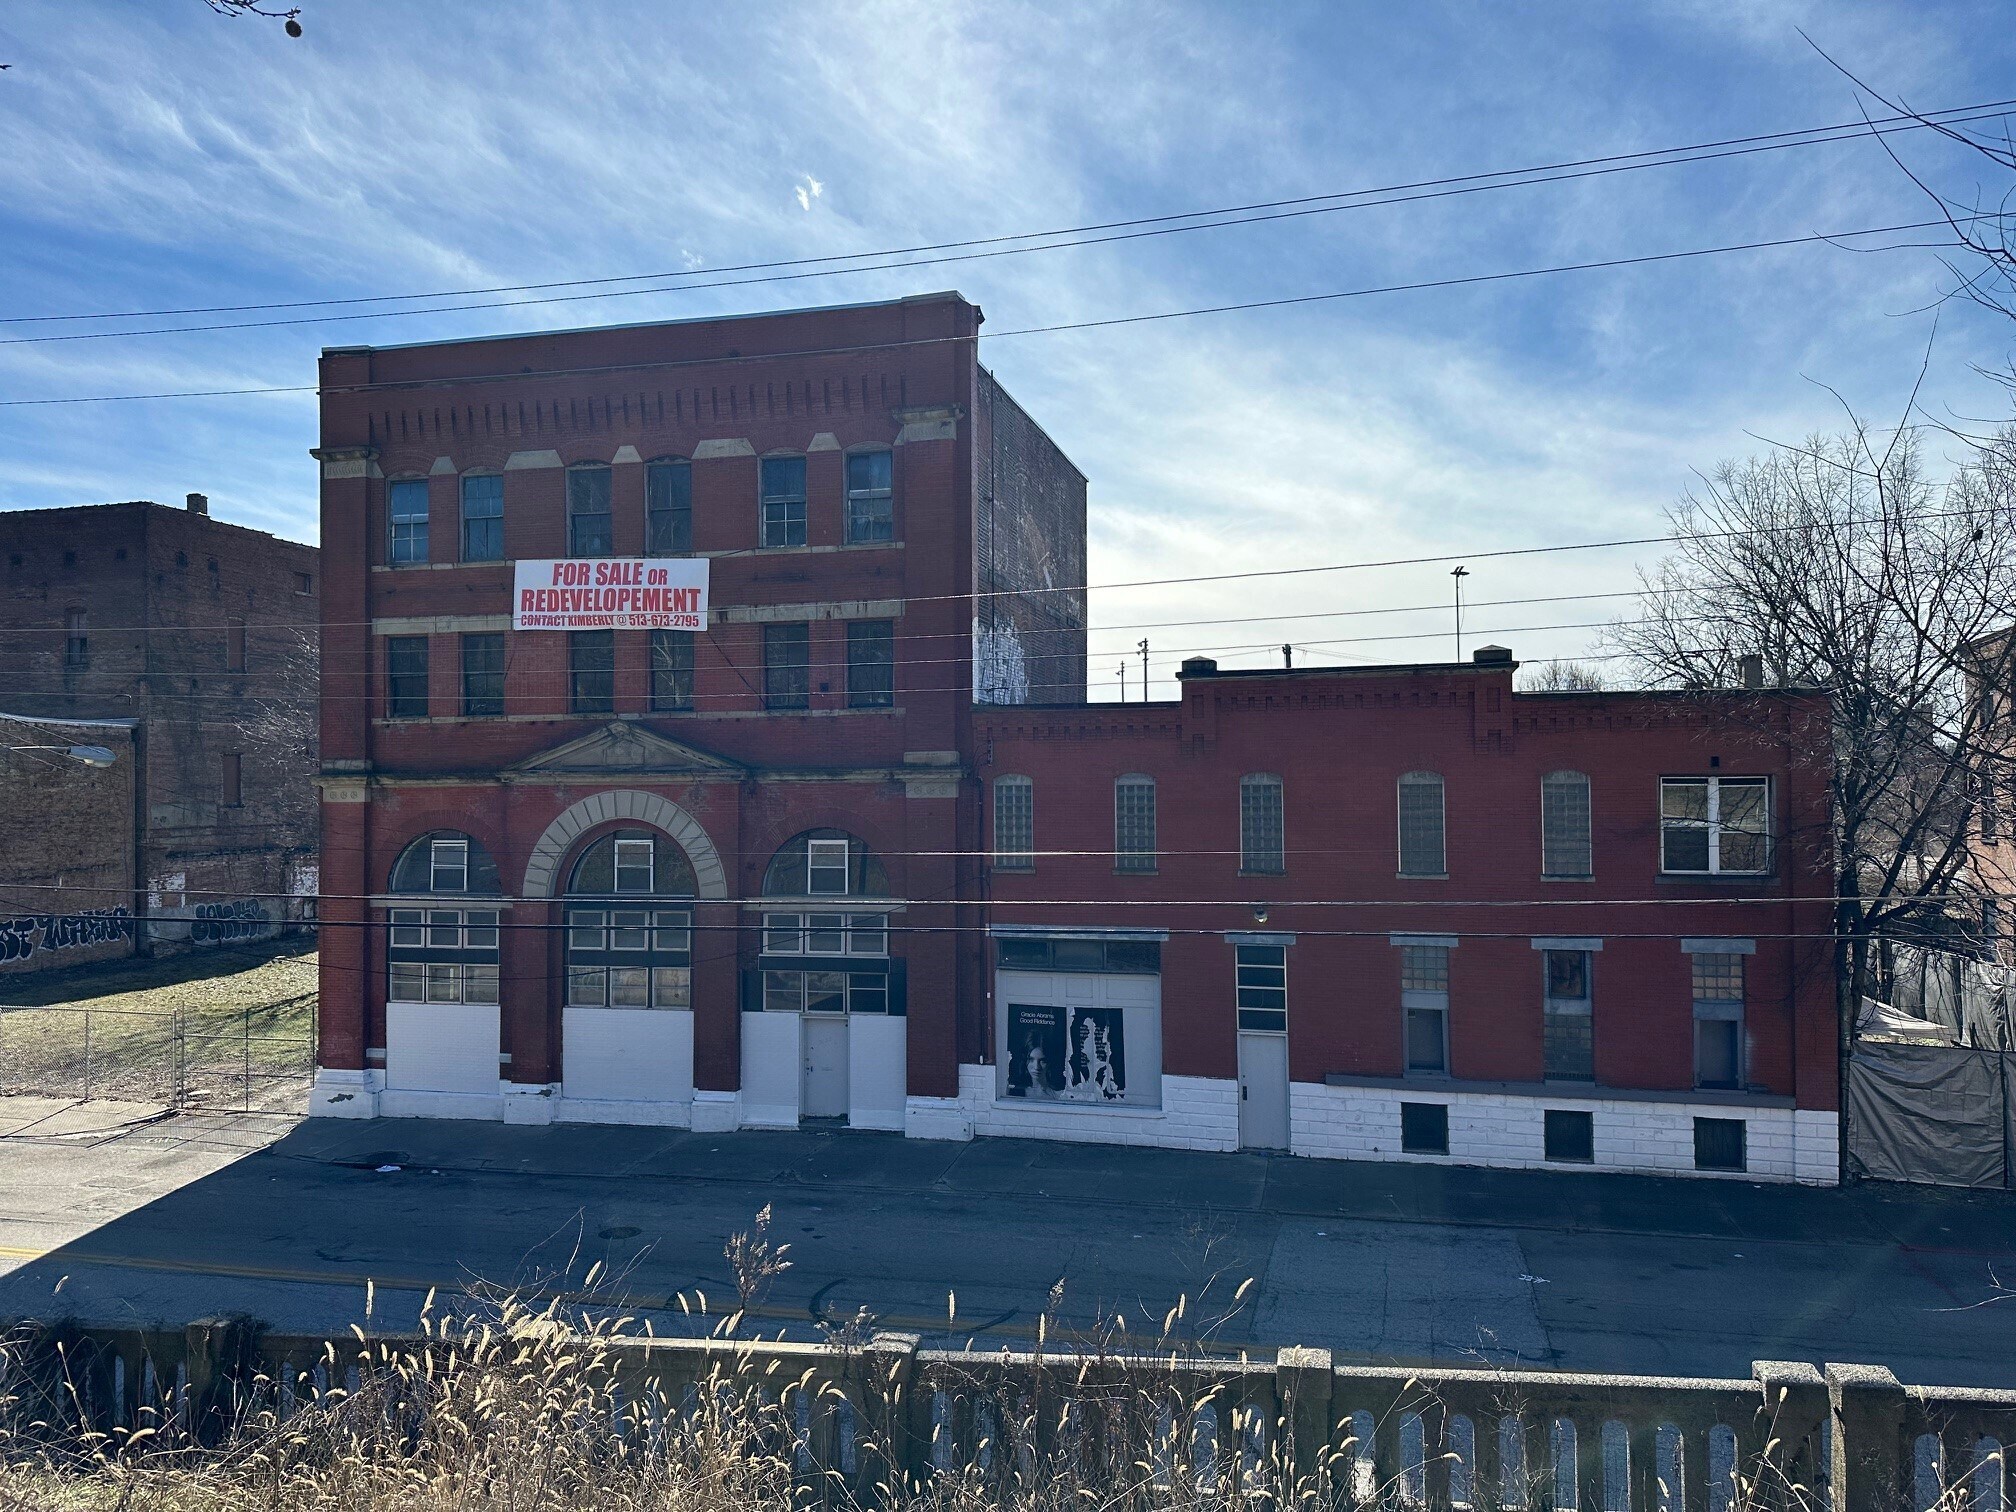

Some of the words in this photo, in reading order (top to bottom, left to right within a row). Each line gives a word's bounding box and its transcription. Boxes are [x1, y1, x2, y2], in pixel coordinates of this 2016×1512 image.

[552, 562, 591, 586] FOR
[595, 562, 643, 586] SALE
[647, 568, 668, 585] OR
[521, 588, 701, 612] REDEVELOPEMENT
[521, 615, 566, 626] CONTACT
[568, 615, 614, 626] KIMBERLY
[616, 615, 627, 626] @
[629, 614, 699, 627] 513-673-2795
